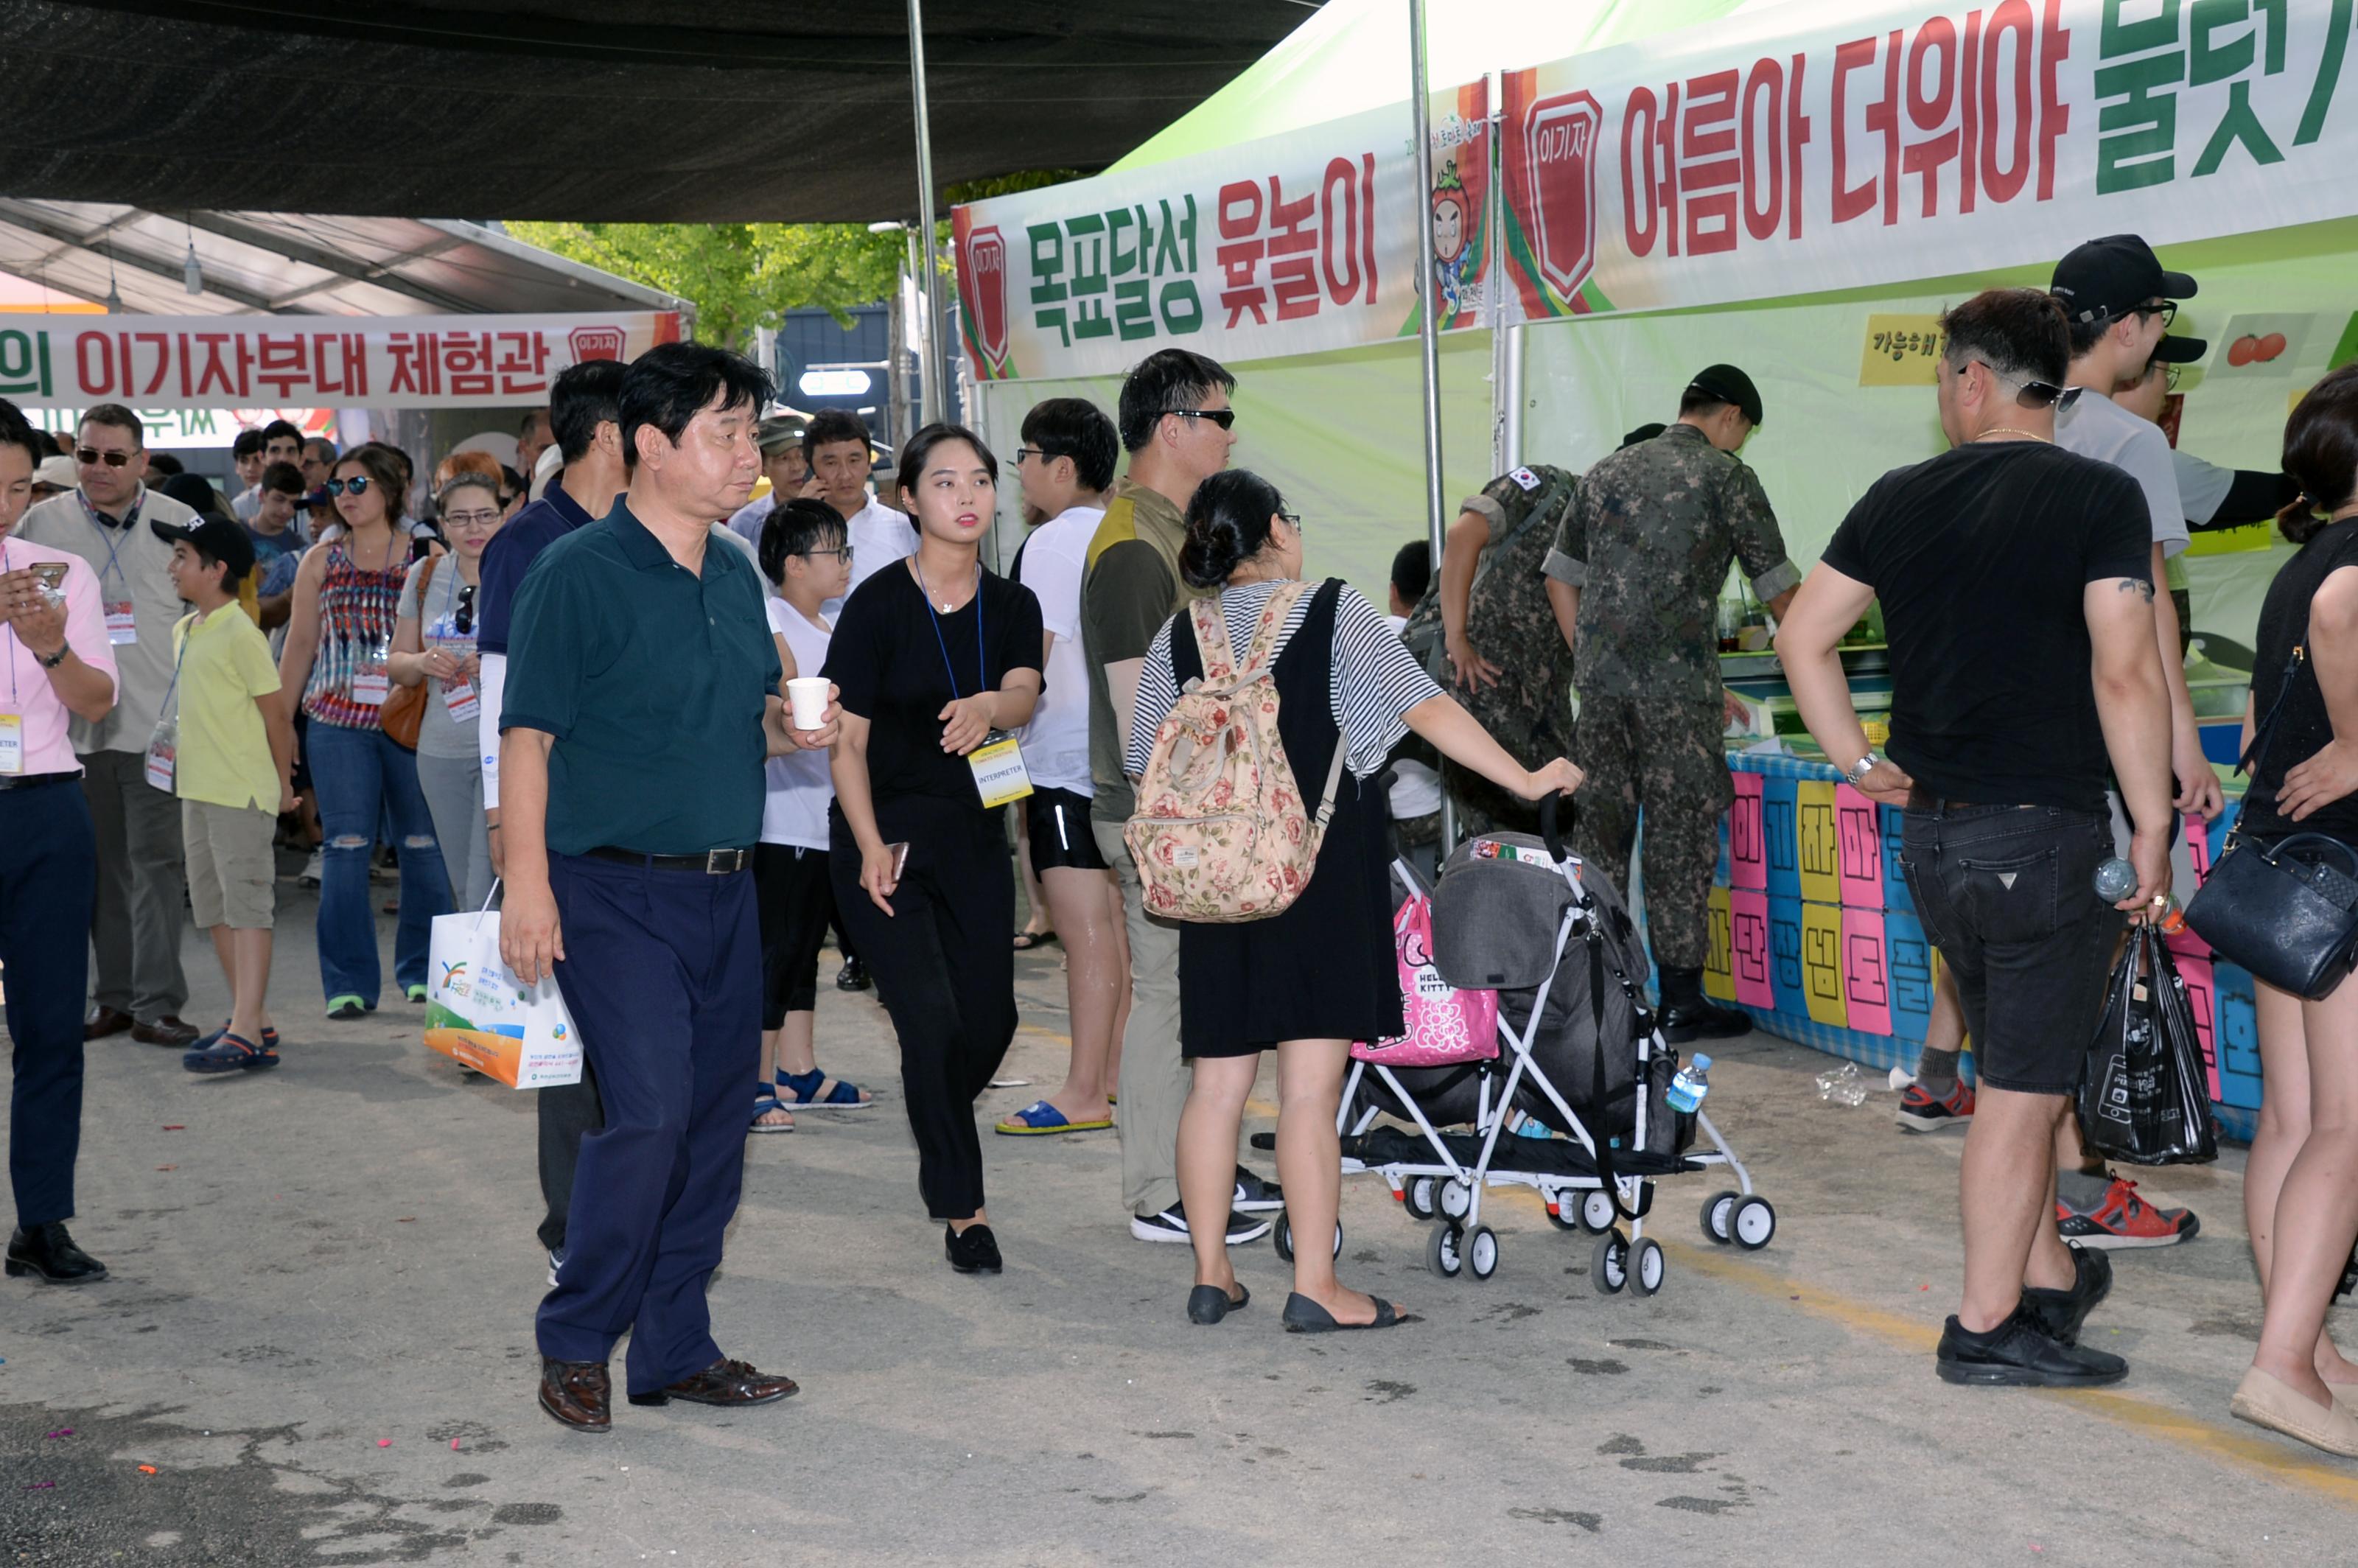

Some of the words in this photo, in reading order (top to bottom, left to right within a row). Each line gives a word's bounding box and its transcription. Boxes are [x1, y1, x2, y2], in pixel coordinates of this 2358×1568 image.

[1540, 120, 1586, 163] 이기자
[1620, 53, 1811, 258] 여름아
[1831, 0, 2071, 226] 더위야
[2094, 0, 2358, 195] 물럿
[974, 245, 1001, 274] 이기자
[1027, 194, 1203, 347] 목표달성
[1217, 153, 1377, 329] 윷놀이
[578, 336, 616, 350] 이기자
[76, 331, 368, 398] 이기자부대
[387, 332, 550, 396] 체험관
[979, 765, 1023, 785] INTERPRETER
[1420, 973, 1441, 981] HEL
[1420, 984, 1450, 993] KITTY
